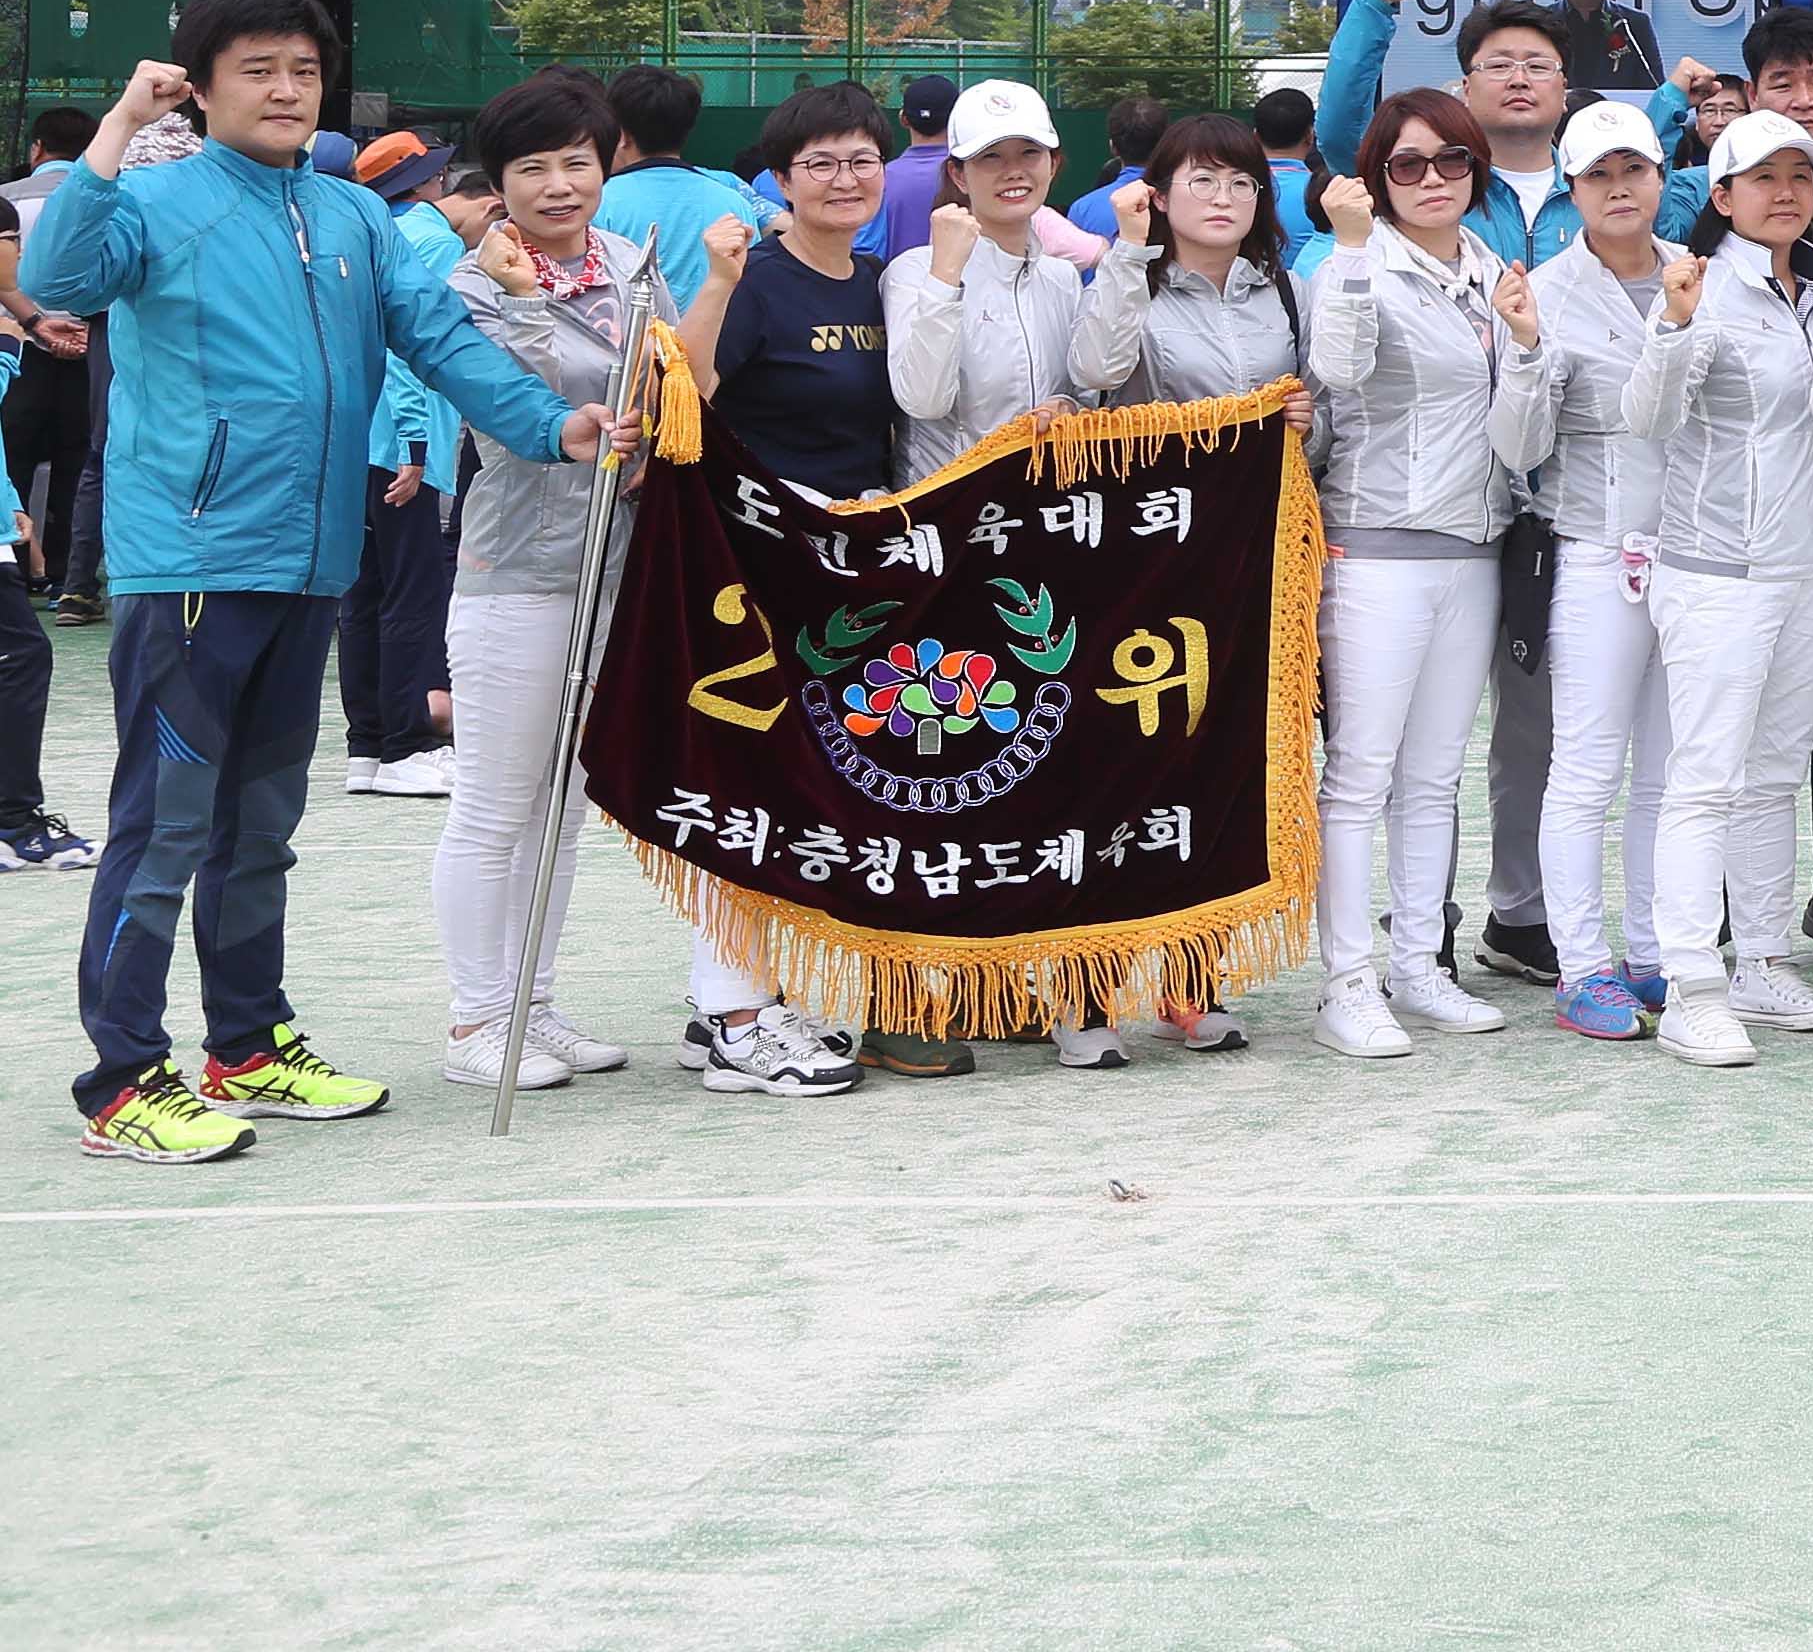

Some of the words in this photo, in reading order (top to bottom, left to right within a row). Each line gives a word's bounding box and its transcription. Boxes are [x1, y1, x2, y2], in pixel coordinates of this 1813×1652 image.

[730, 475, 1194, 577] 도민체육대회
[687, 583, 790, 732] 2
[1094, 616, 1210, 738] 위
